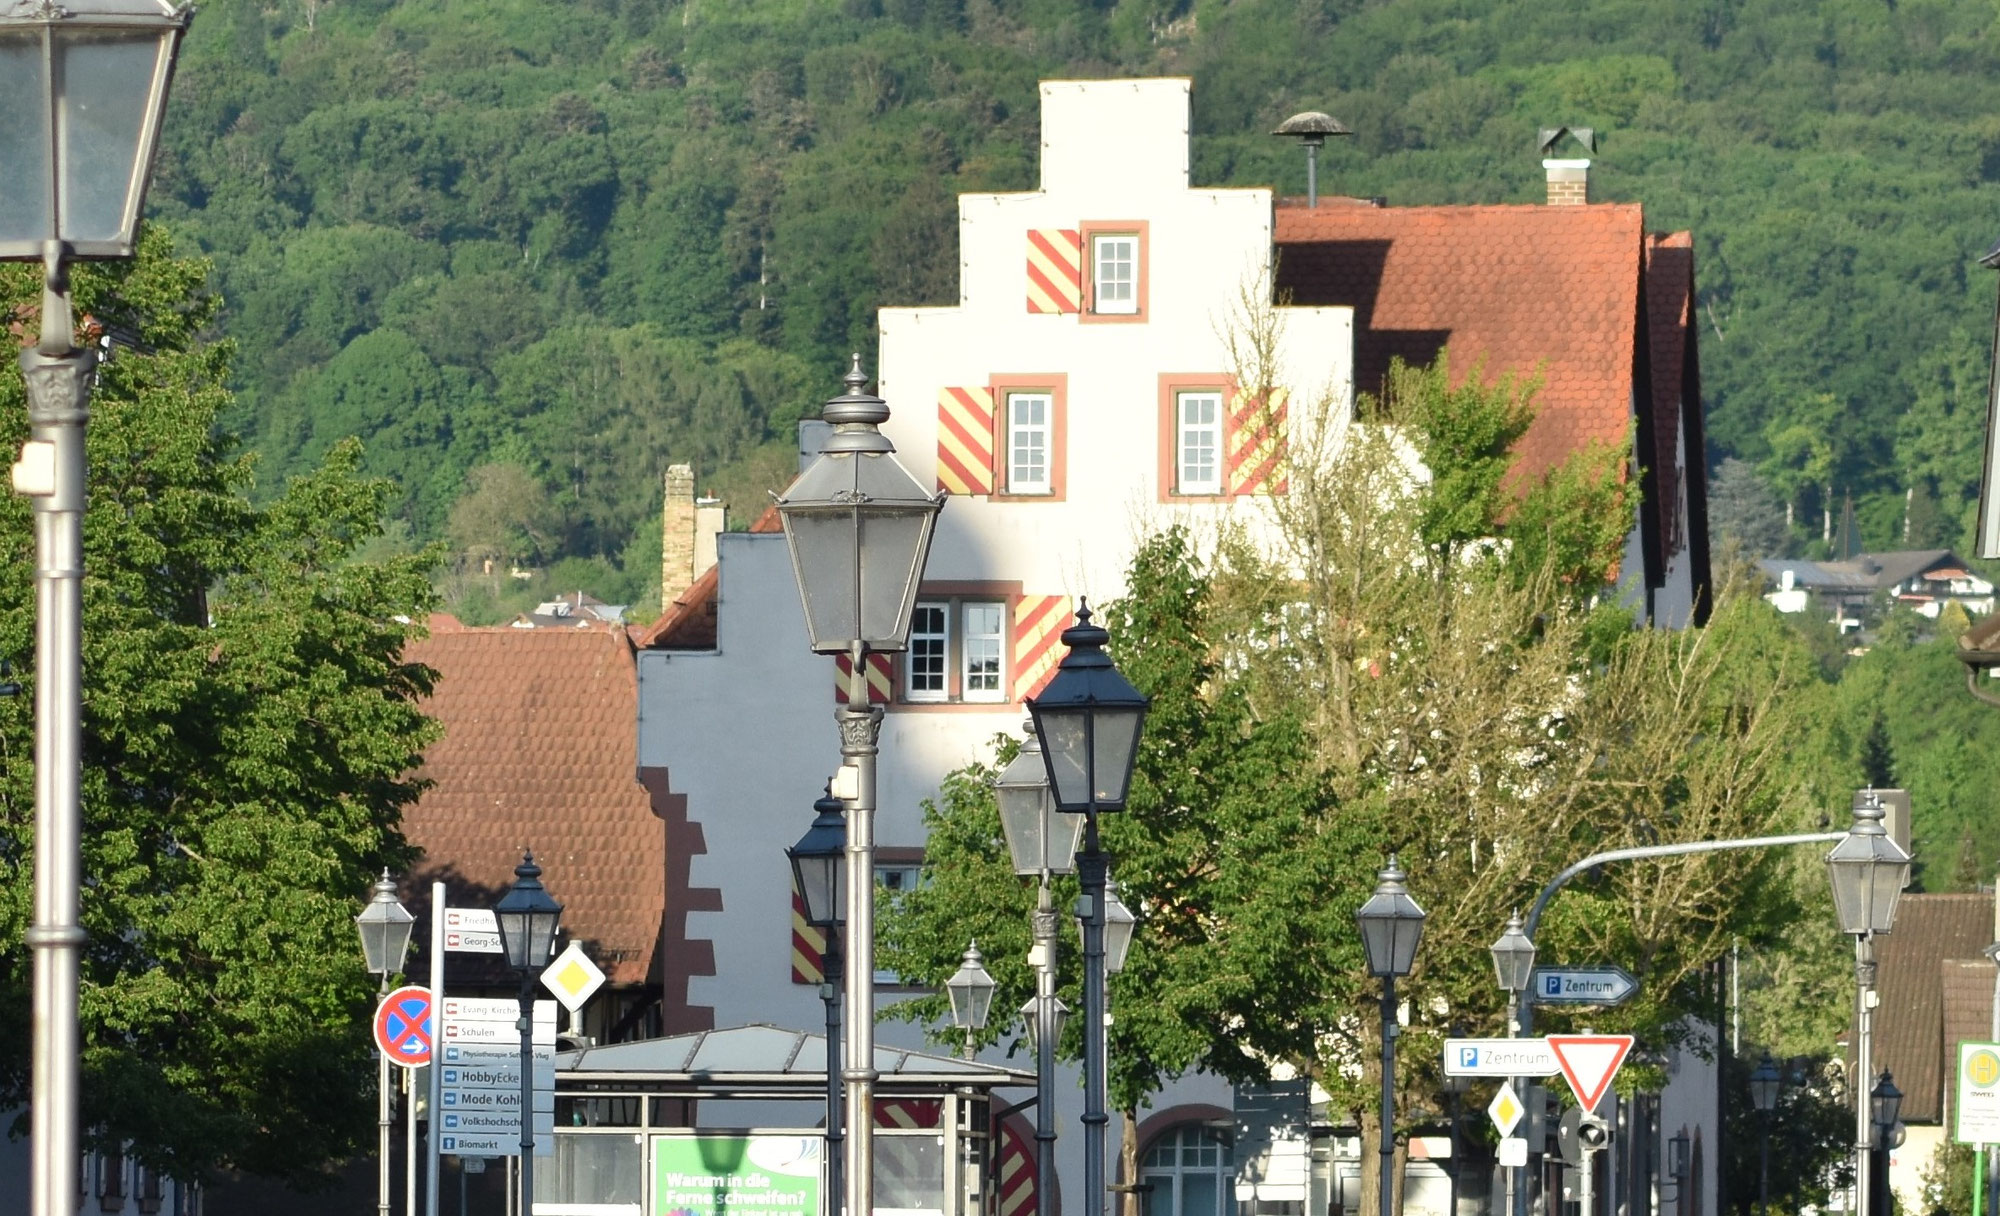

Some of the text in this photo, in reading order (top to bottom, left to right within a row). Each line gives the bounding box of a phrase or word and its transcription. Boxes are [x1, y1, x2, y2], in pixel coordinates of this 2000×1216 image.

[464, 916, 496, 925] Friedho
[464, 937, 501, 947] Georg-Sc
[1566, 979, 1613, 993] Zentrum
[461, 1027, 495, 1037] Schulen
[463, 1050, 507, 1059] Physiotherapie
[1485, 1051, 1549, 1065] Zentrum
[462, 1072, 519, 1085] HobbyEcke
[461, 1093, 522, 1106] Mode Kohl
[462, 1117, 522, 1127] Volkshochsch
[459, 1140, 498, 1149] Biomarkt
[666, 1173, 770, 1188] Warum in die
[667, 1190, 806, 1205] Ferne schweifen?
